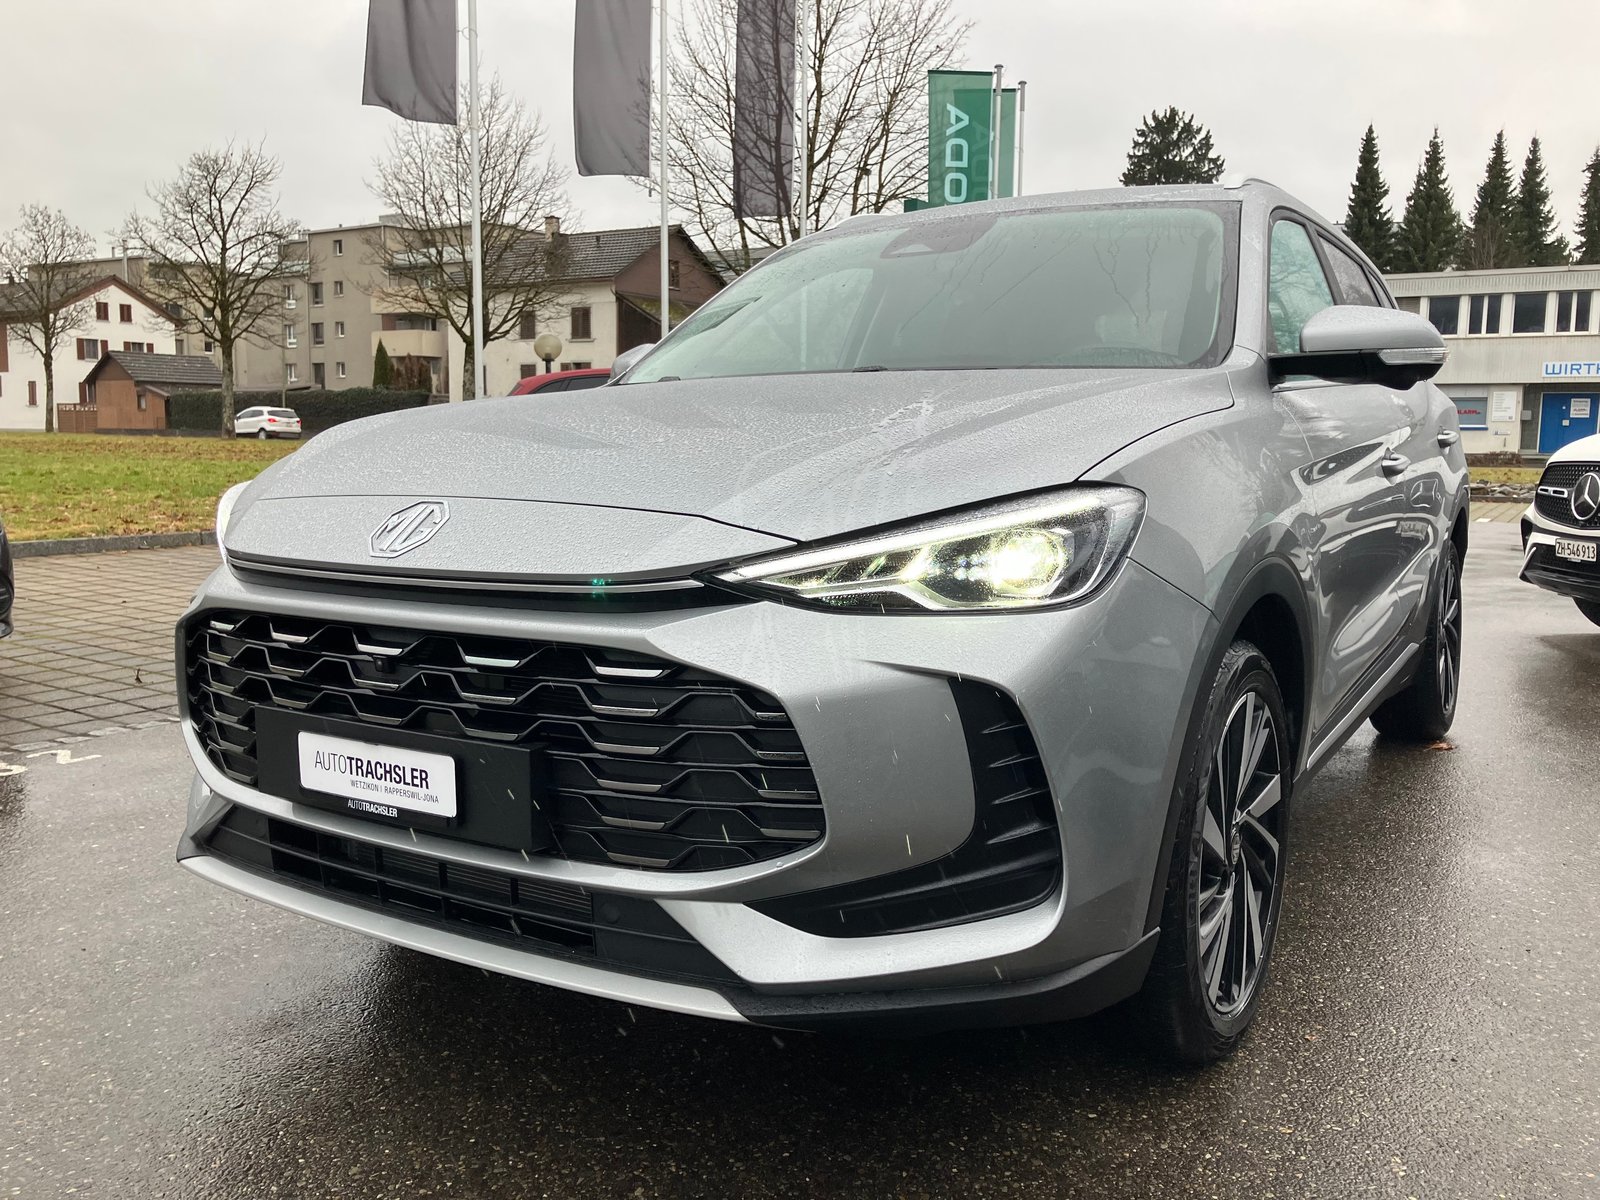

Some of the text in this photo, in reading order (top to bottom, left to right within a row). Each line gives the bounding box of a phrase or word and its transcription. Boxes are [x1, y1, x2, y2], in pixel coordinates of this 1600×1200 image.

[374, 504, 444, 554] MG
[314, 750, 430, 789] AUTOTRACHSLER
[350, 779, 379, 793] WETZIKON
[384, 785, 439, 804] RAPPERSWIL-JONA
[347, 799, 398, 818] AUTOTRACHSLER
